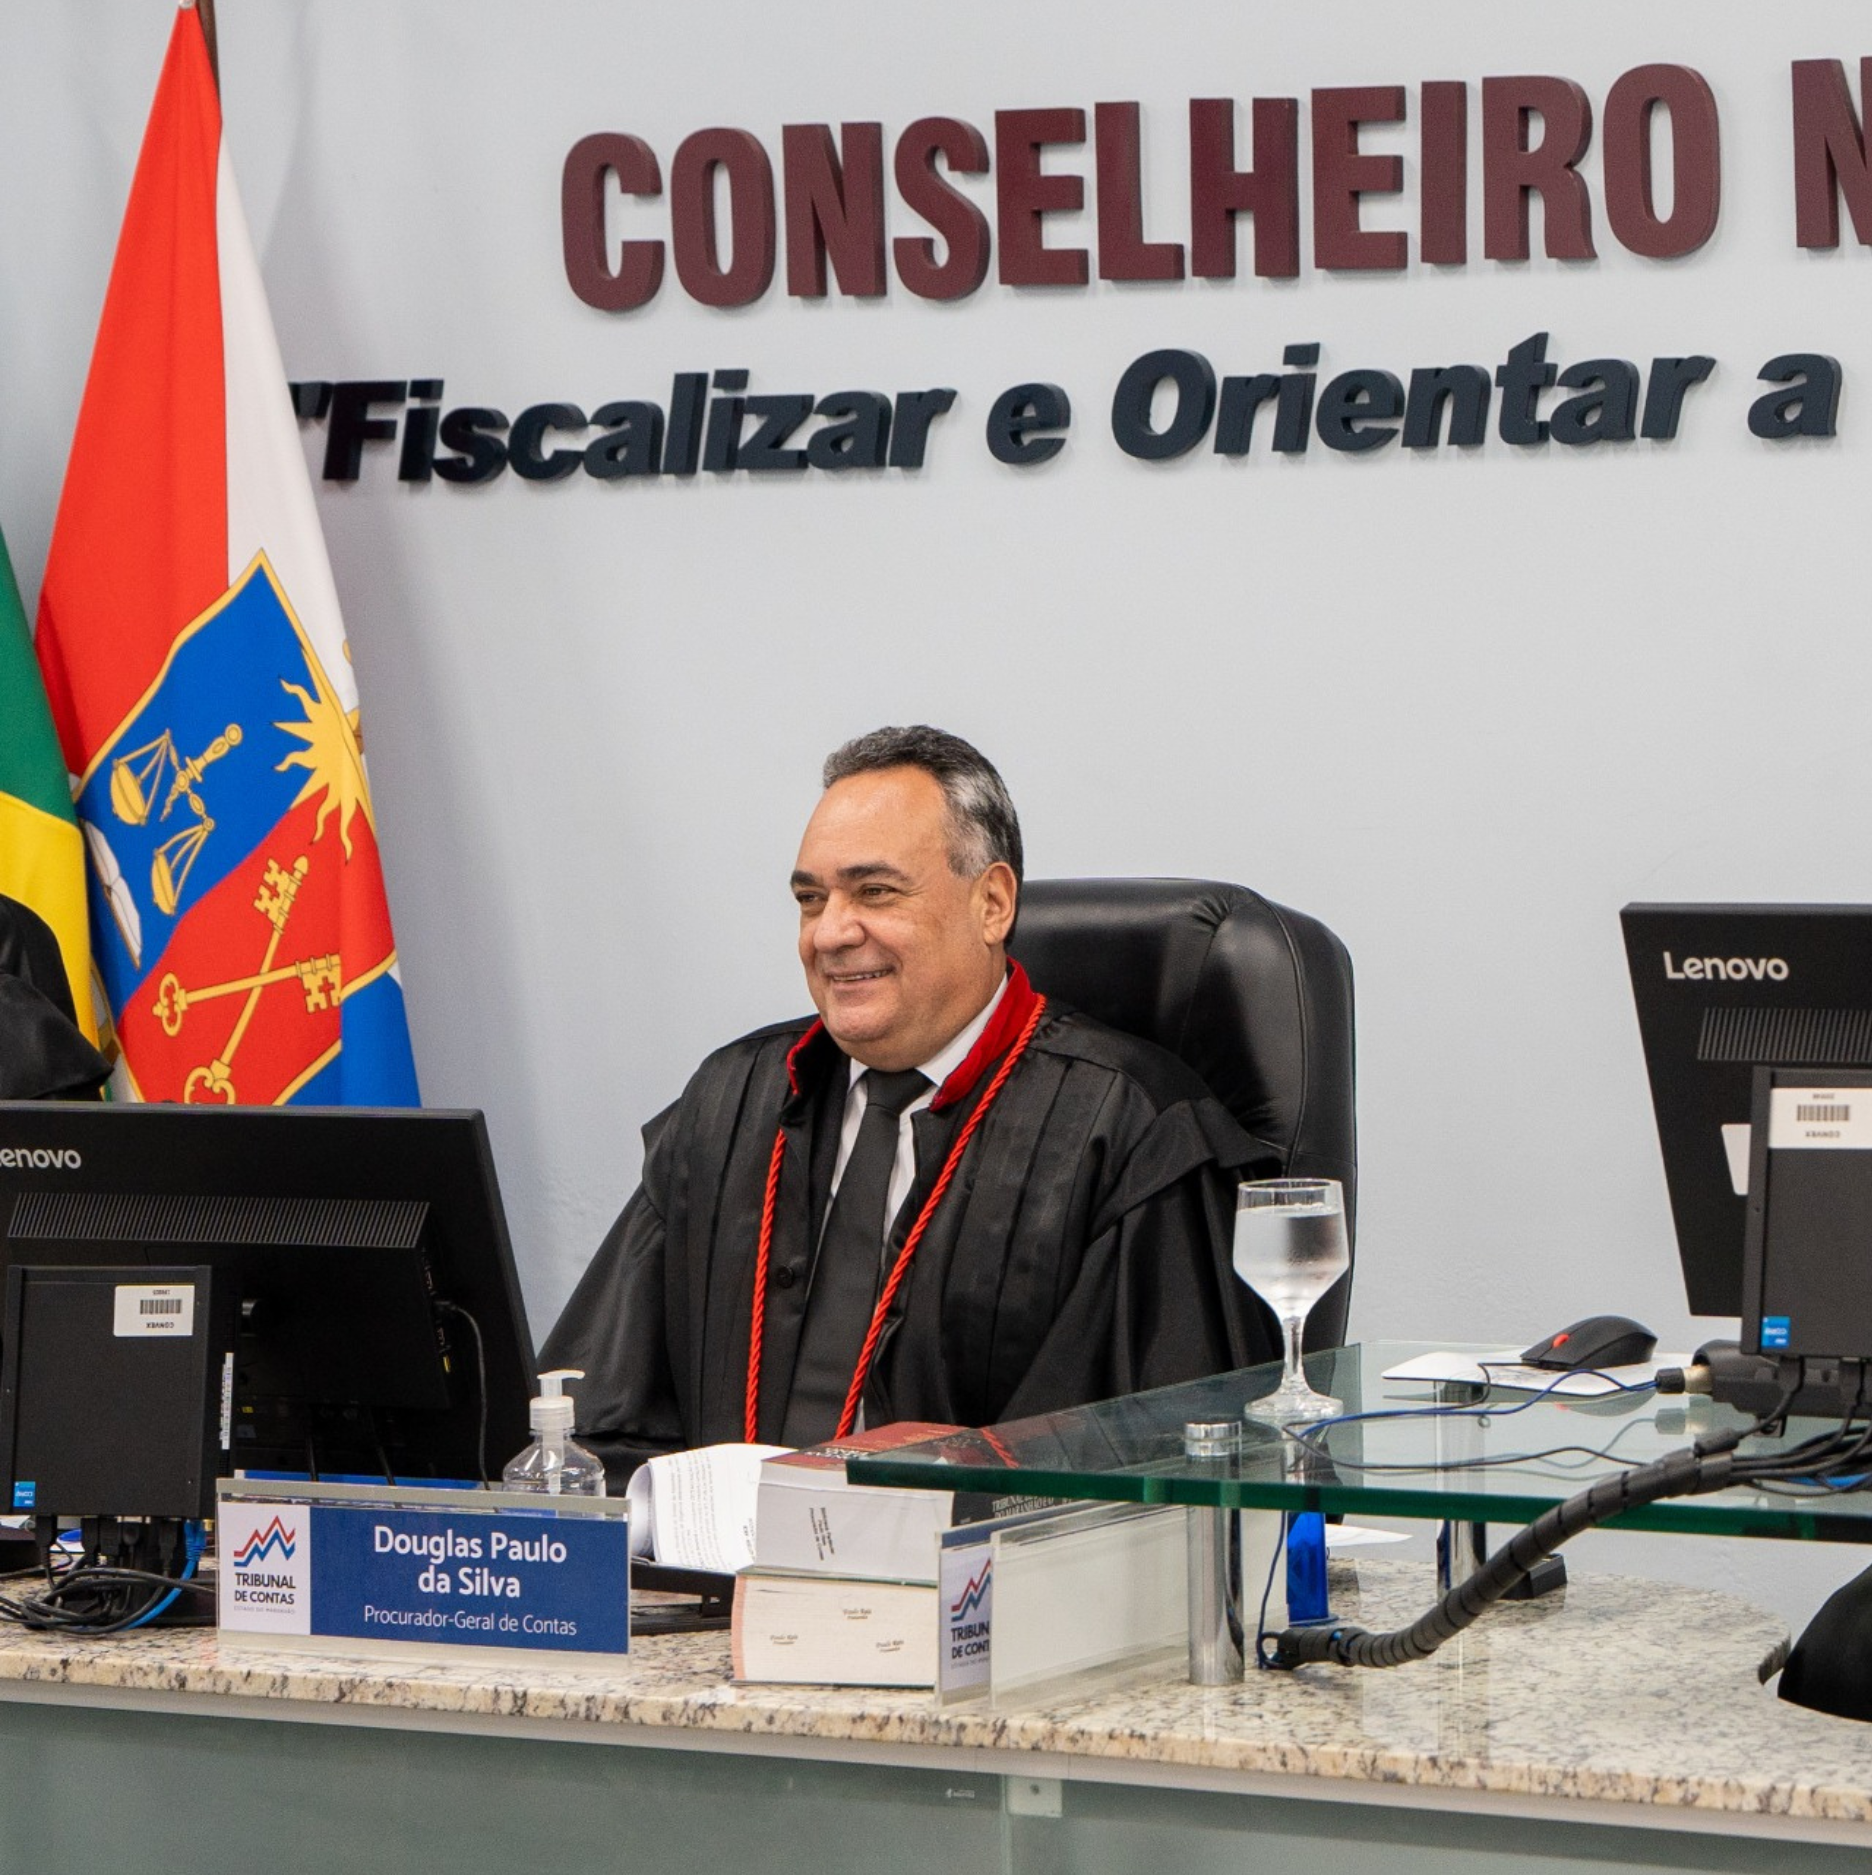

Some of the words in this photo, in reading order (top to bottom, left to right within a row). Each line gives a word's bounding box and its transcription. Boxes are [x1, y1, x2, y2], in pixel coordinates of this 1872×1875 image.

[562, 64, 1721, 312] CONSELHEIRO
[986, 382, 1071, 465] e
[1112, 332, 1716, 461] Orientar
[1748, 353, 1842, 439] a
[1663, 951, 1789, 982] Lenovo
[0, 1148, 82, 1169] enovo
[374, 1525, 483, 1564] Douglas
[490, 1532, 567, 1563] Paulo
[235, 1572, 296, 1589] TRIBUNAL
[418, 1565, 451, 1593] da
[458, 1567, 521, 1598] Silva
[234, 1590, 248, 1602] DE
[249, 1590, 295, 1605] CONTAS
[364, 1605, 495, 1631] Procurador-Geral
[498, 1613, 519, 1632] de
[523, 1614, 577, 1636] Contas
[950, 1620, 990, 1643] TRIBUN
[964, 1638, 990, 1656] CONT
